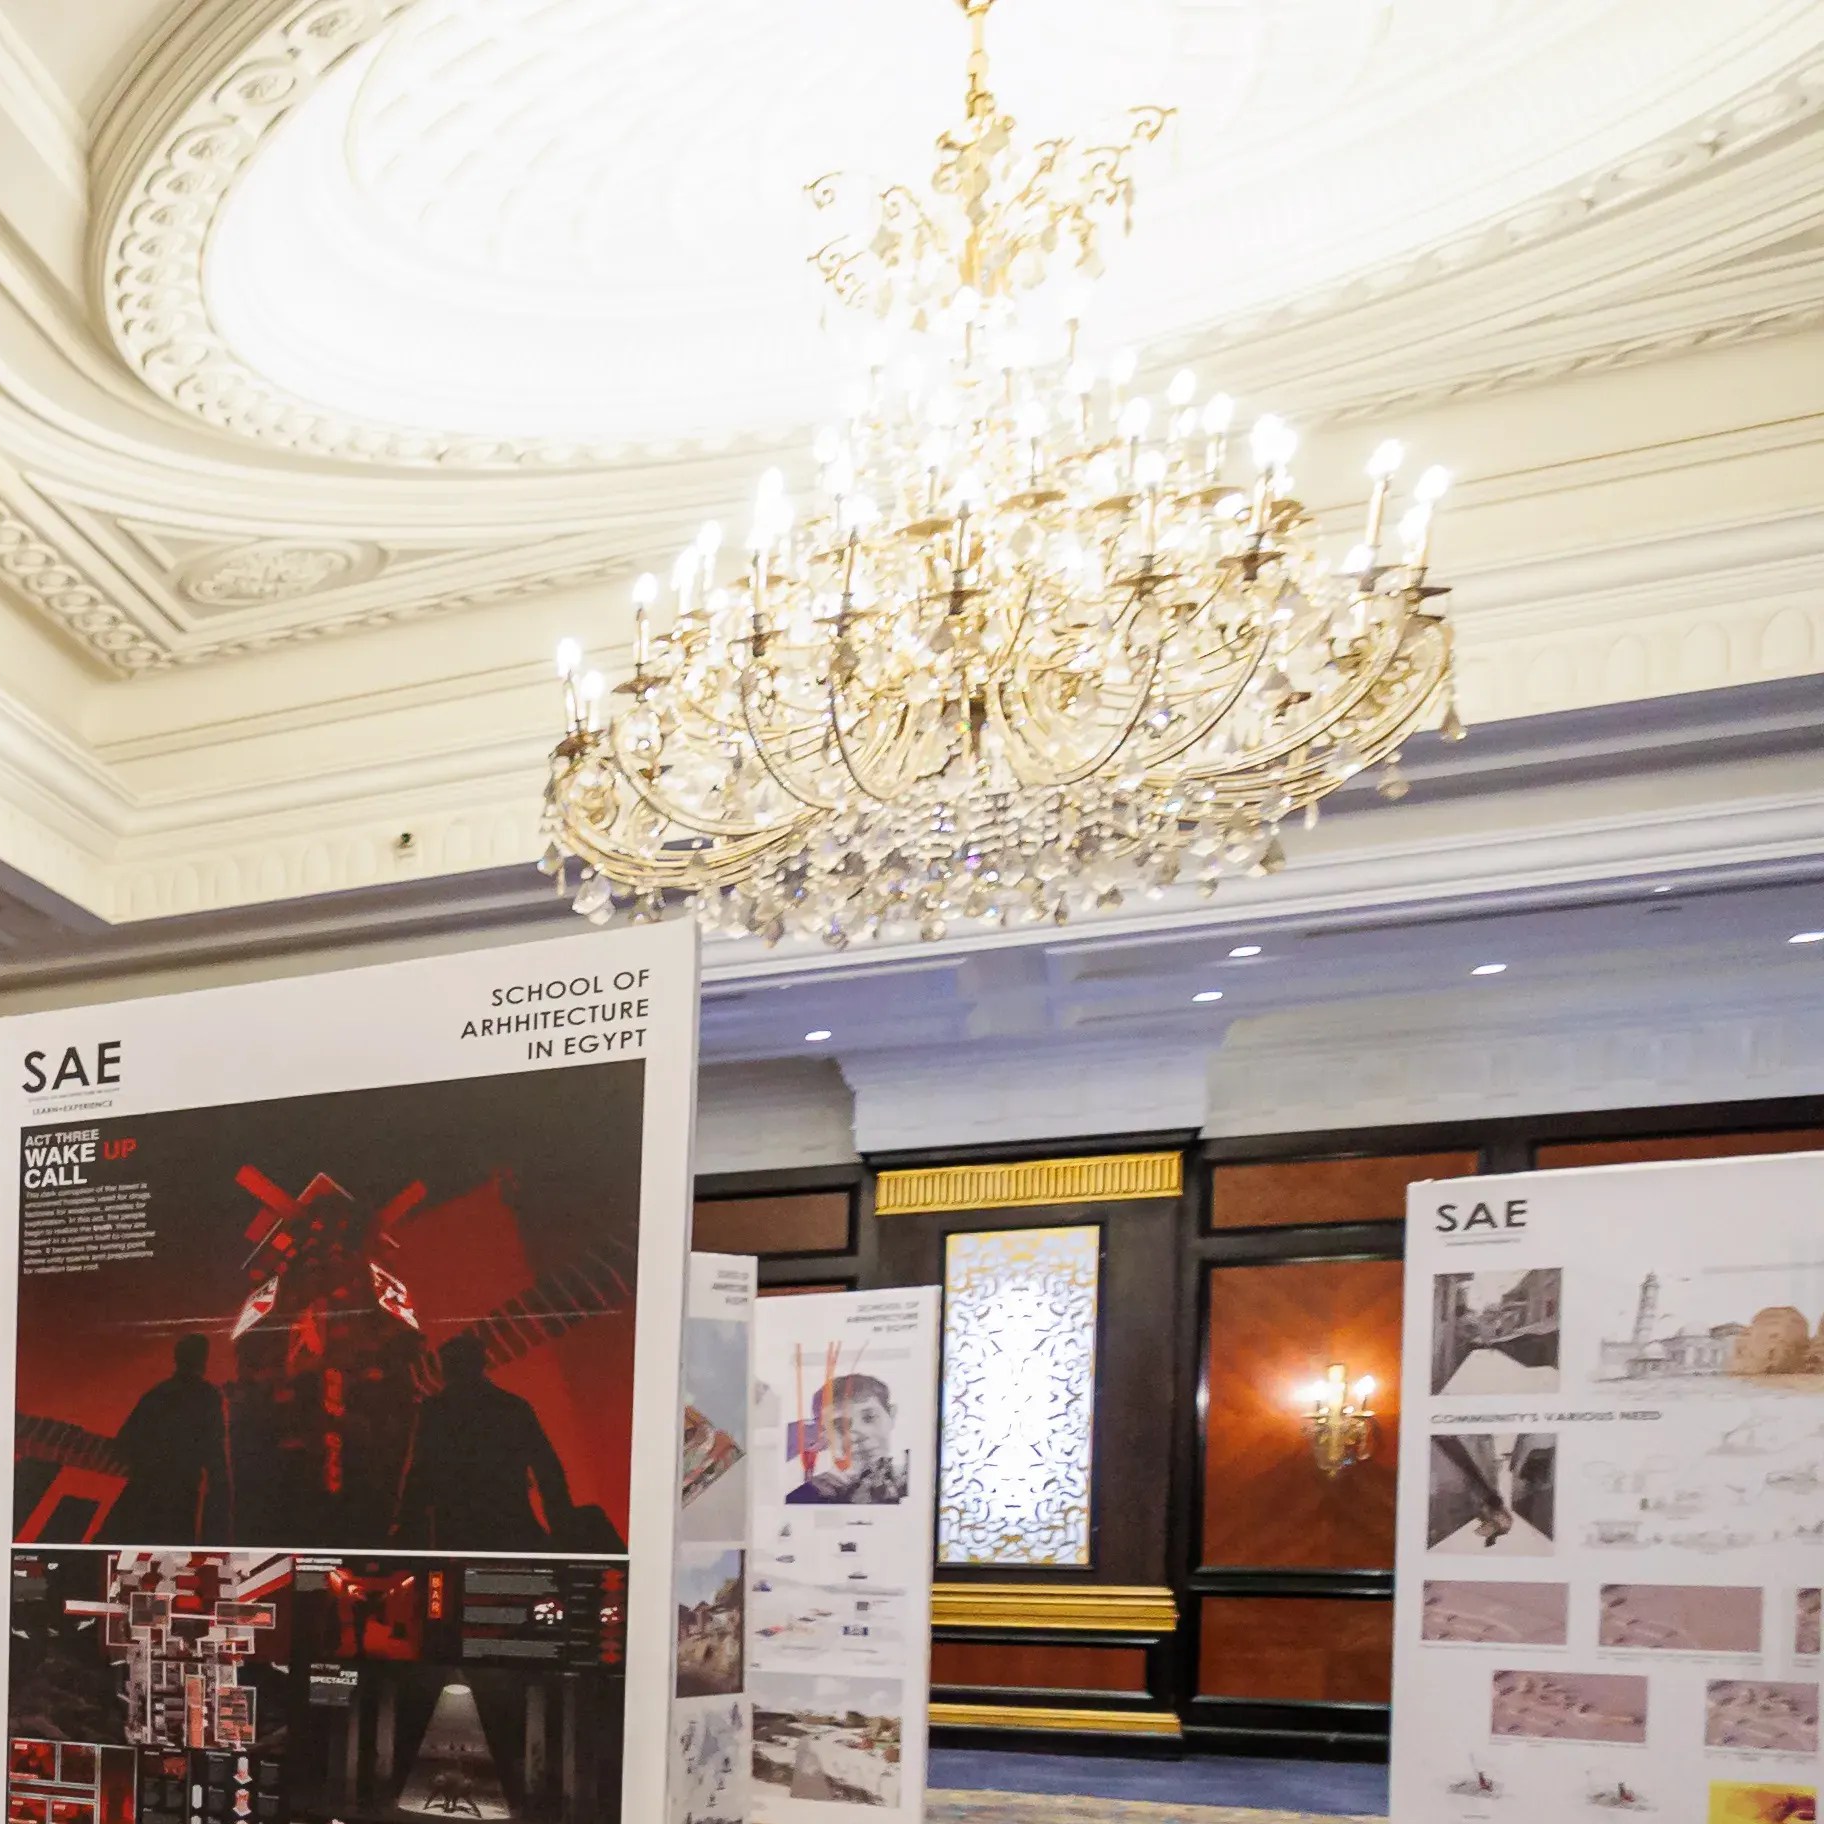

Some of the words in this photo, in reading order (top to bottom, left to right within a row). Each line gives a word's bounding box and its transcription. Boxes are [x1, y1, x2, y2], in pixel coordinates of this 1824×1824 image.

[491, 976, 603, 1007] SCHOOL
[613, 968, 650, 990] OF
[460, 998, 649, 1039] ARHHITECTURE
[527, 1040, 553, 1060] IN
[564, 1028, 647, 1056] EGYPT
[22, 1040, 121, 1094] SAE
[25, 1134, 51, 1147] ACT
[55, 1128, 100, 1144] THREE
[25, 1142, 96, 1168] WAKE
[102, 1136, 138, 1161] UP
[24, 1165, 88, 1189] CALL
[1435, 1199, 1529, 1234] SAE
